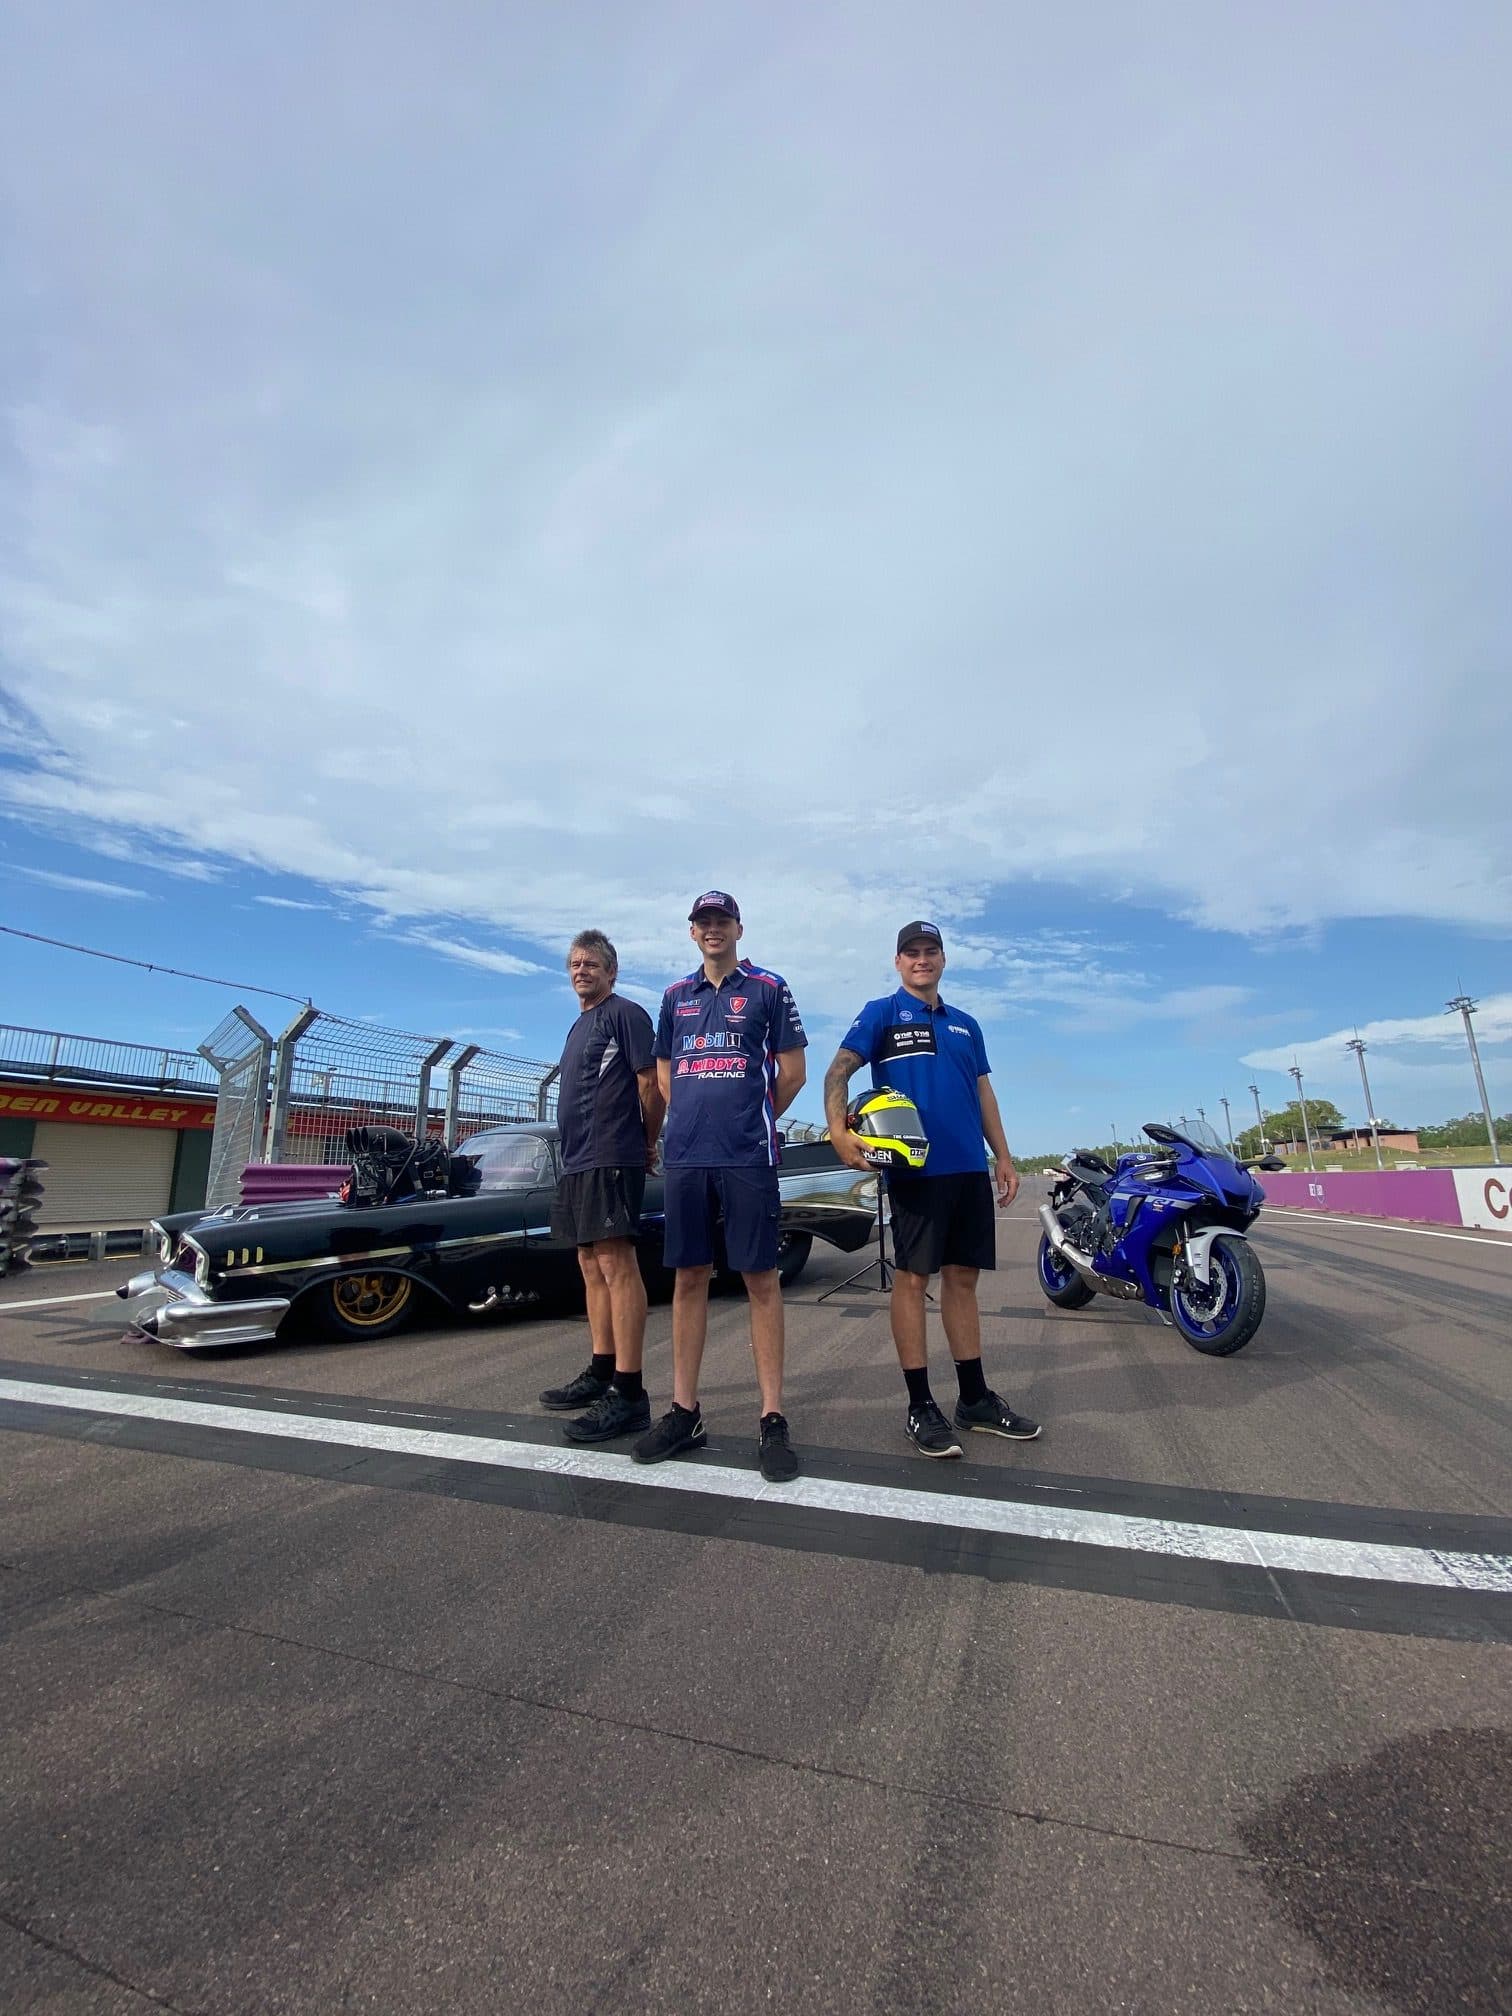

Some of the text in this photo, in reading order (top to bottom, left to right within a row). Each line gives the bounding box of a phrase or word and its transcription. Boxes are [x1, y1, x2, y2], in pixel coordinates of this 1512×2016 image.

[683, 1032, 725, 1051] Mobil
[690, 1057, 747, 1073] MIDDY'S
[697, 1071, 745, 1079] RACING
[68, 1101, 188, 1122] VALLEY
[1484, 1177, 1512, 1220] C
